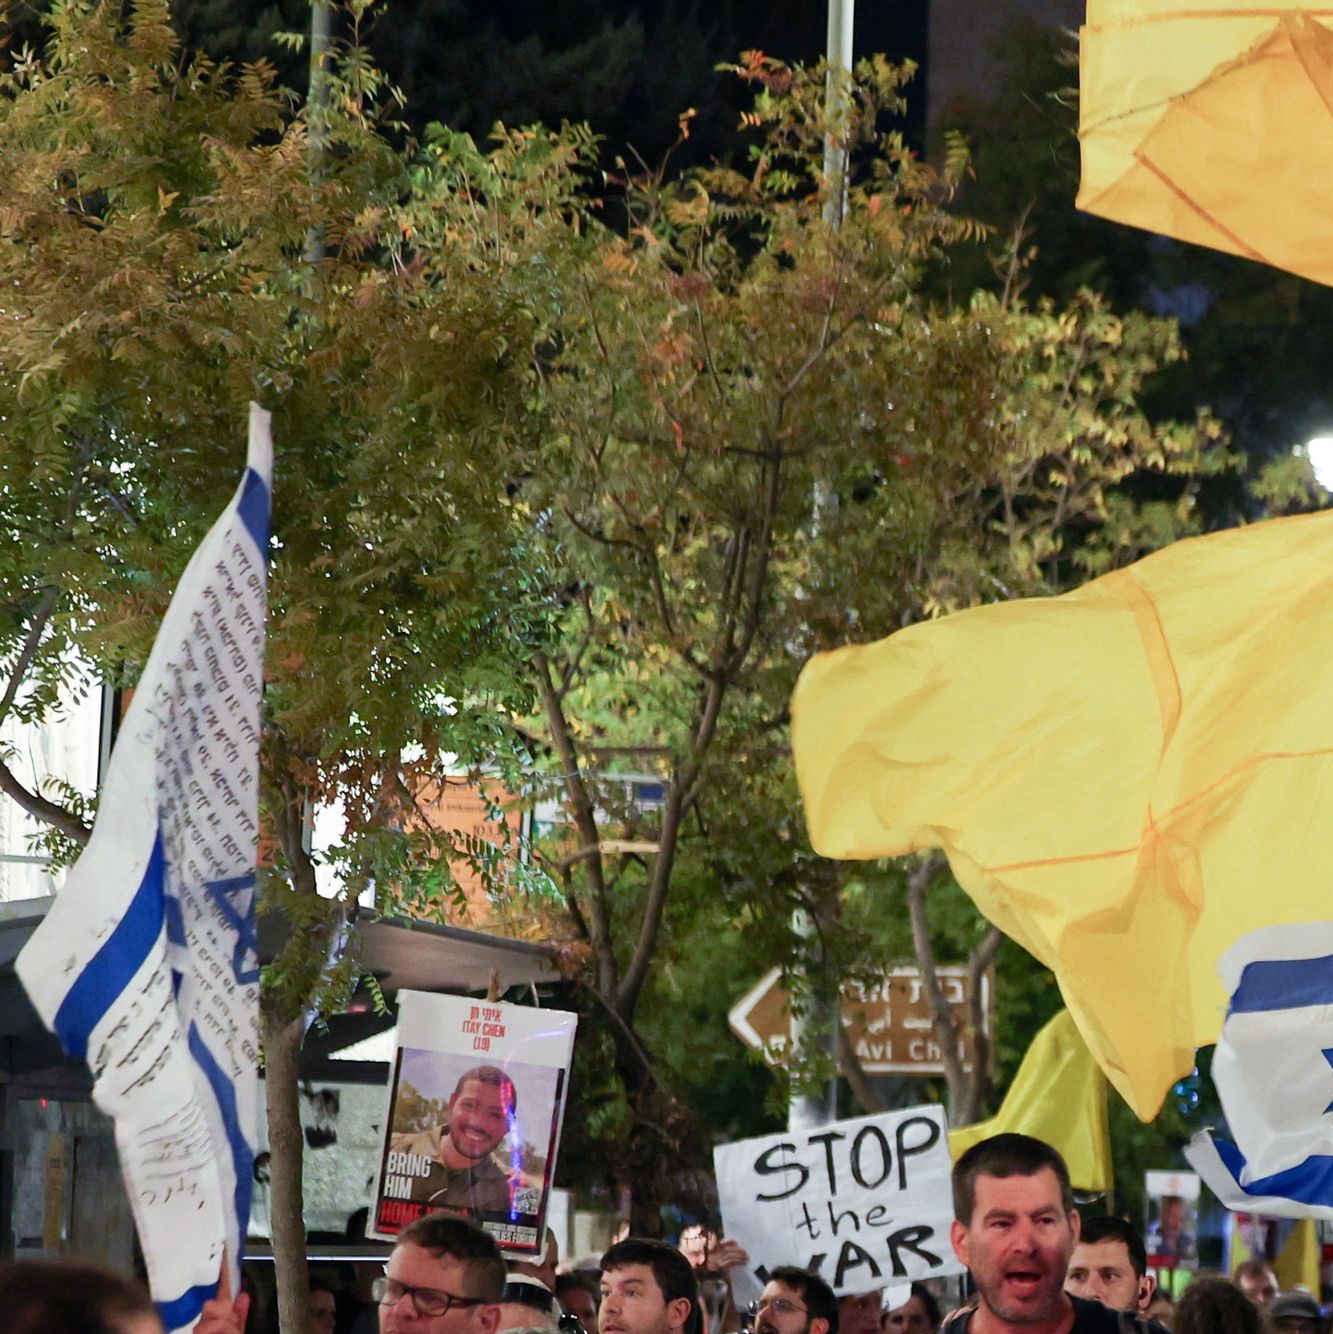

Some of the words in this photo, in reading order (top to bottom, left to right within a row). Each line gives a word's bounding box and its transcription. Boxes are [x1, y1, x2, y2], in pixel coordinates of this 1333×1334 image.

[461, 1019, 481, 1035] ITAY
[481, 1021, 506, 1038] CHEN
[473, 1035, 491, 1052] (19)
[856, 1036, 893, 1061] Avi
[908, 1037, 966, 1061] Chi
[386, 1151, 433, 1178] BRING
[753, 1116, 941, 1202] STOP
[383, 1174, 414, 1200] HIM
[380, 1201, 422, 1225] HOME
[795, 1201, 895, 1241] the
